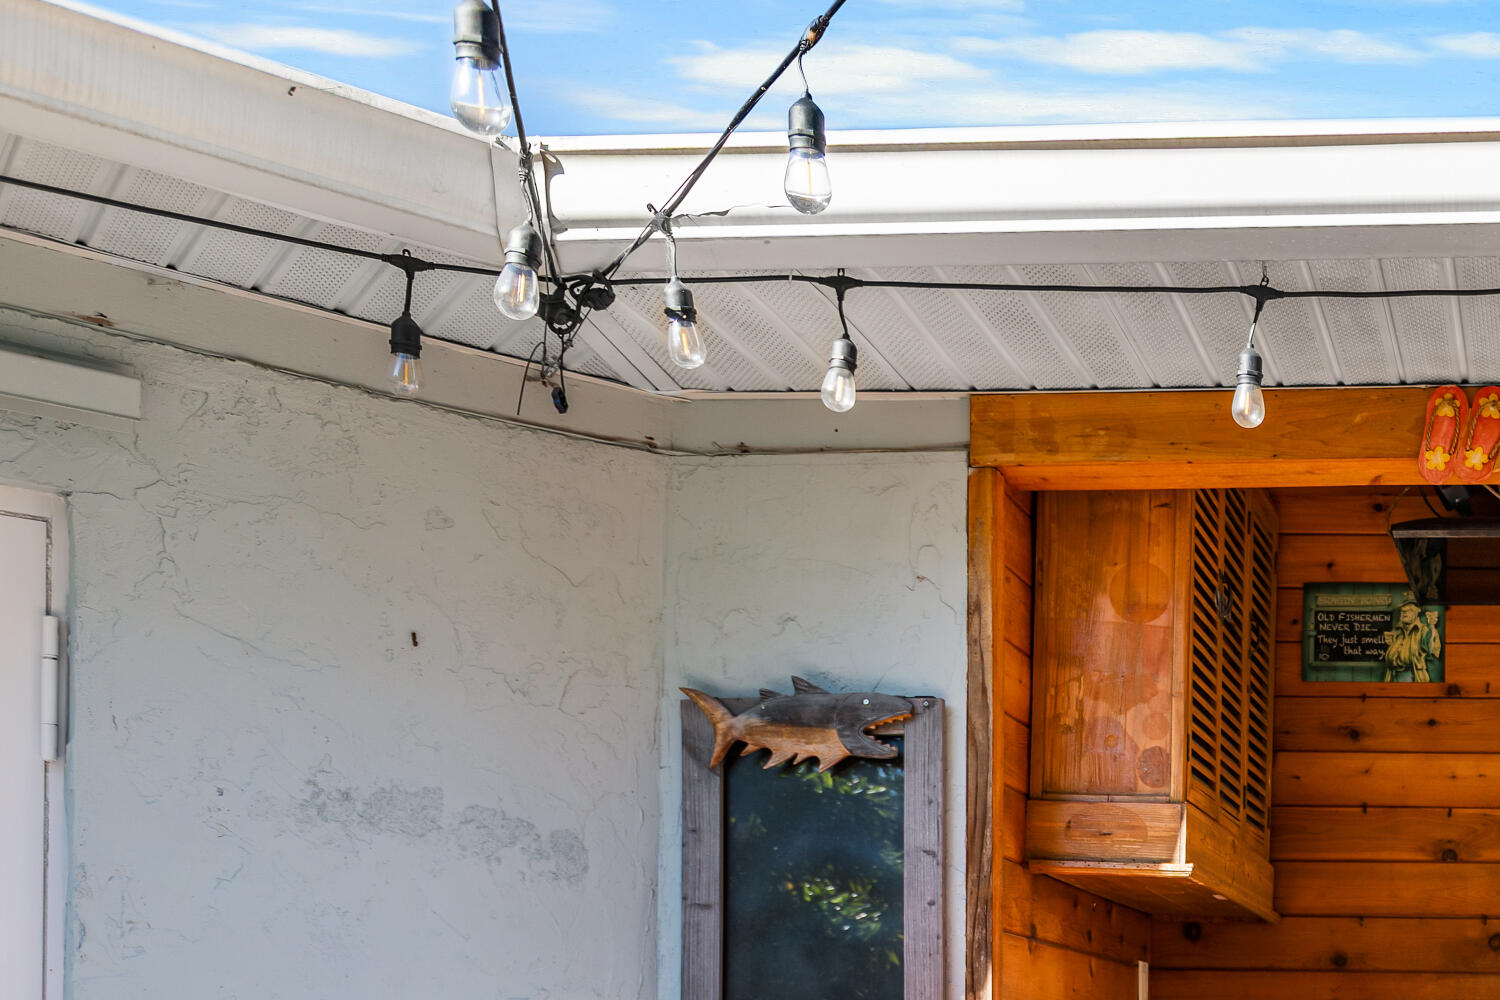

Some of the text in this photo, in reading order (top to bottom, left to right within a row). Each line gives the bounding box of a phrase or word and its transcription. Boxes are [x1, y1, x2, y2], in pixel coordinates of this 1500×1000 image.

[1317, 612, 1391, 622] OLD FISHERMEN
[1319, 623, 1351, 631] NEVER
[1317, 633, 1385, 648] They just smell
[1344, 645, 1362, 655] that
